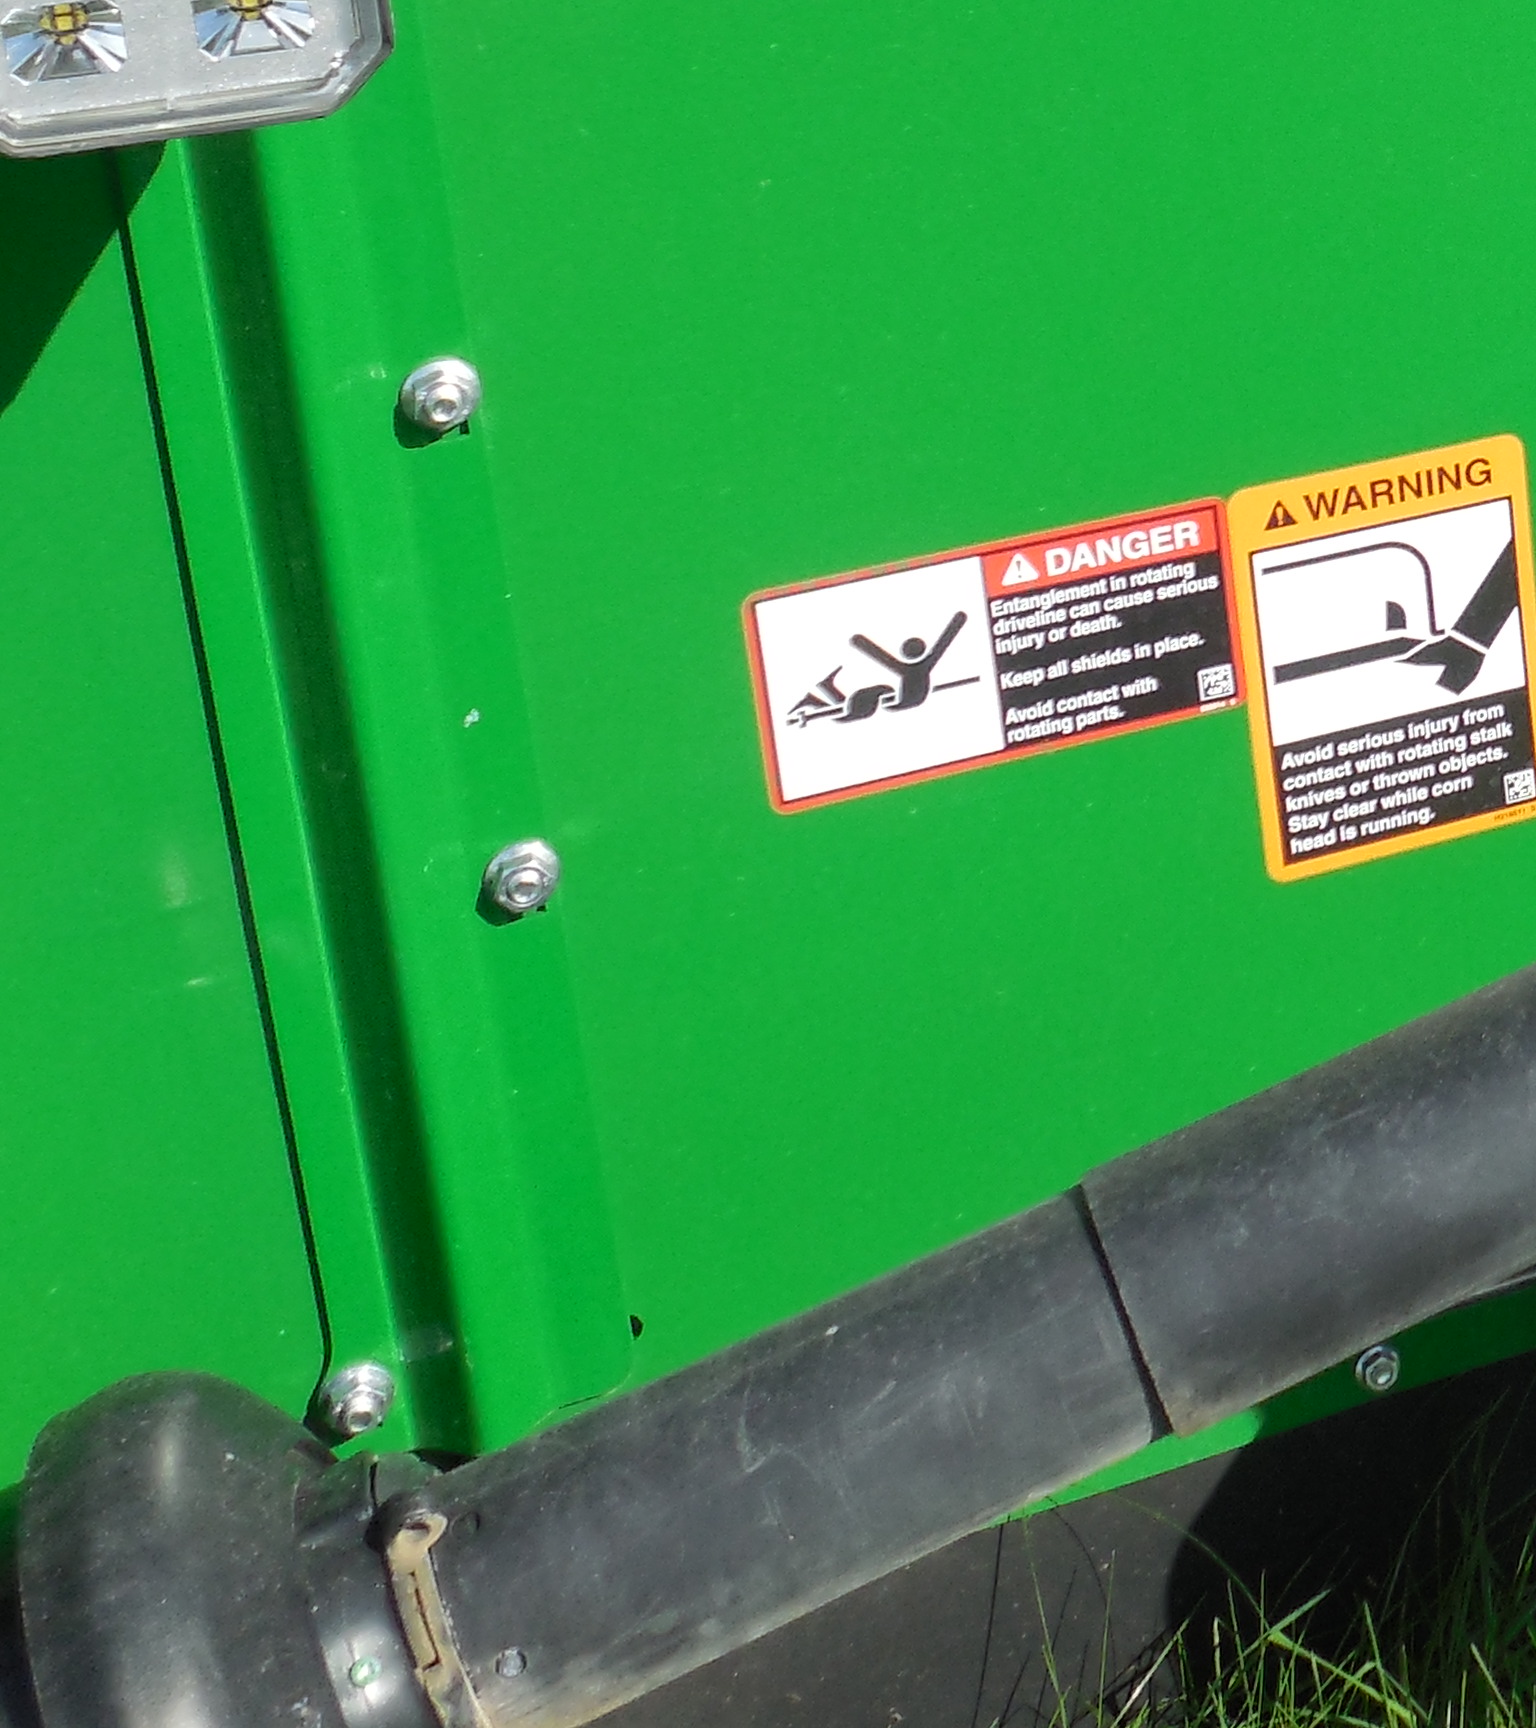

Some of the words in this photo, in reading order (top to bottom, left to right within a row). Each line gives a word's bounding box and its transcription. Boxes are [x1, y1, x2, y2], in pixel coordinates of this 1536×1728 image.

[1303, 457, 1493, 522] WARNING
[1044, 519, 1200, 577] DANGER
[990, 578, 1107, 617] Entanglement
[1109, 575, 1126, 592] in
[1129, 561, 1196, 590] rotating
[992, 608, 1067, 636] driveline
[1069, 601, 1101, 621] can
[1103, 588, 1154, 612] cause
[1156, 574, 1220, 601] serious
[994, 631, 1045, 655] injury
[1048, 627, 1067, 643] or
[1069, 615, 1122, 638] death.
[999, 670, 1044, 691] Keep
[1046, 660, 1070, 680] all
[1070, 645, 1132, 674] shields
[1134, 641, 1151, 658] in
[1154, 632, 1206, 659] place.
[1004, 697, 1054, 725] Avoid
[1056, 686, 1121, 714] contact
[1122, 675, 1160, 699] with
[1006, 717, 1073, 744] rotating
[1075, 705, 1127, 731] parts.
[1280, 744, 1335, 771] Avoid
[1337, 727, 1405, 756] serious
[1407, 714, 1459, 740] injury
[1462, 703, 1505, 726] from
[1282, 766, 1352, 792] contact
[1354, 752, 1395, 774] with
[1397, 734, 1467, 764] rotating
[1469, 720, 1514, 746] stalk
[1284, 785, 1347, 813] knives
[1349, 779, 1370, 797] or
[1372, 763, 1435, 792] thrown
[1438, 746, 1509, 775] objects.
[1287, 811, 1336, 836] Stay
[1331, 797, 1378, 823] clear
[1380, 784, 1428, 811] while
[1431, 775, 1474, 799] corn
[1290, 828, 1338, 855] head
[1339, 823, 1357, 842] is
[1360, 805, 1436, 837] running.
